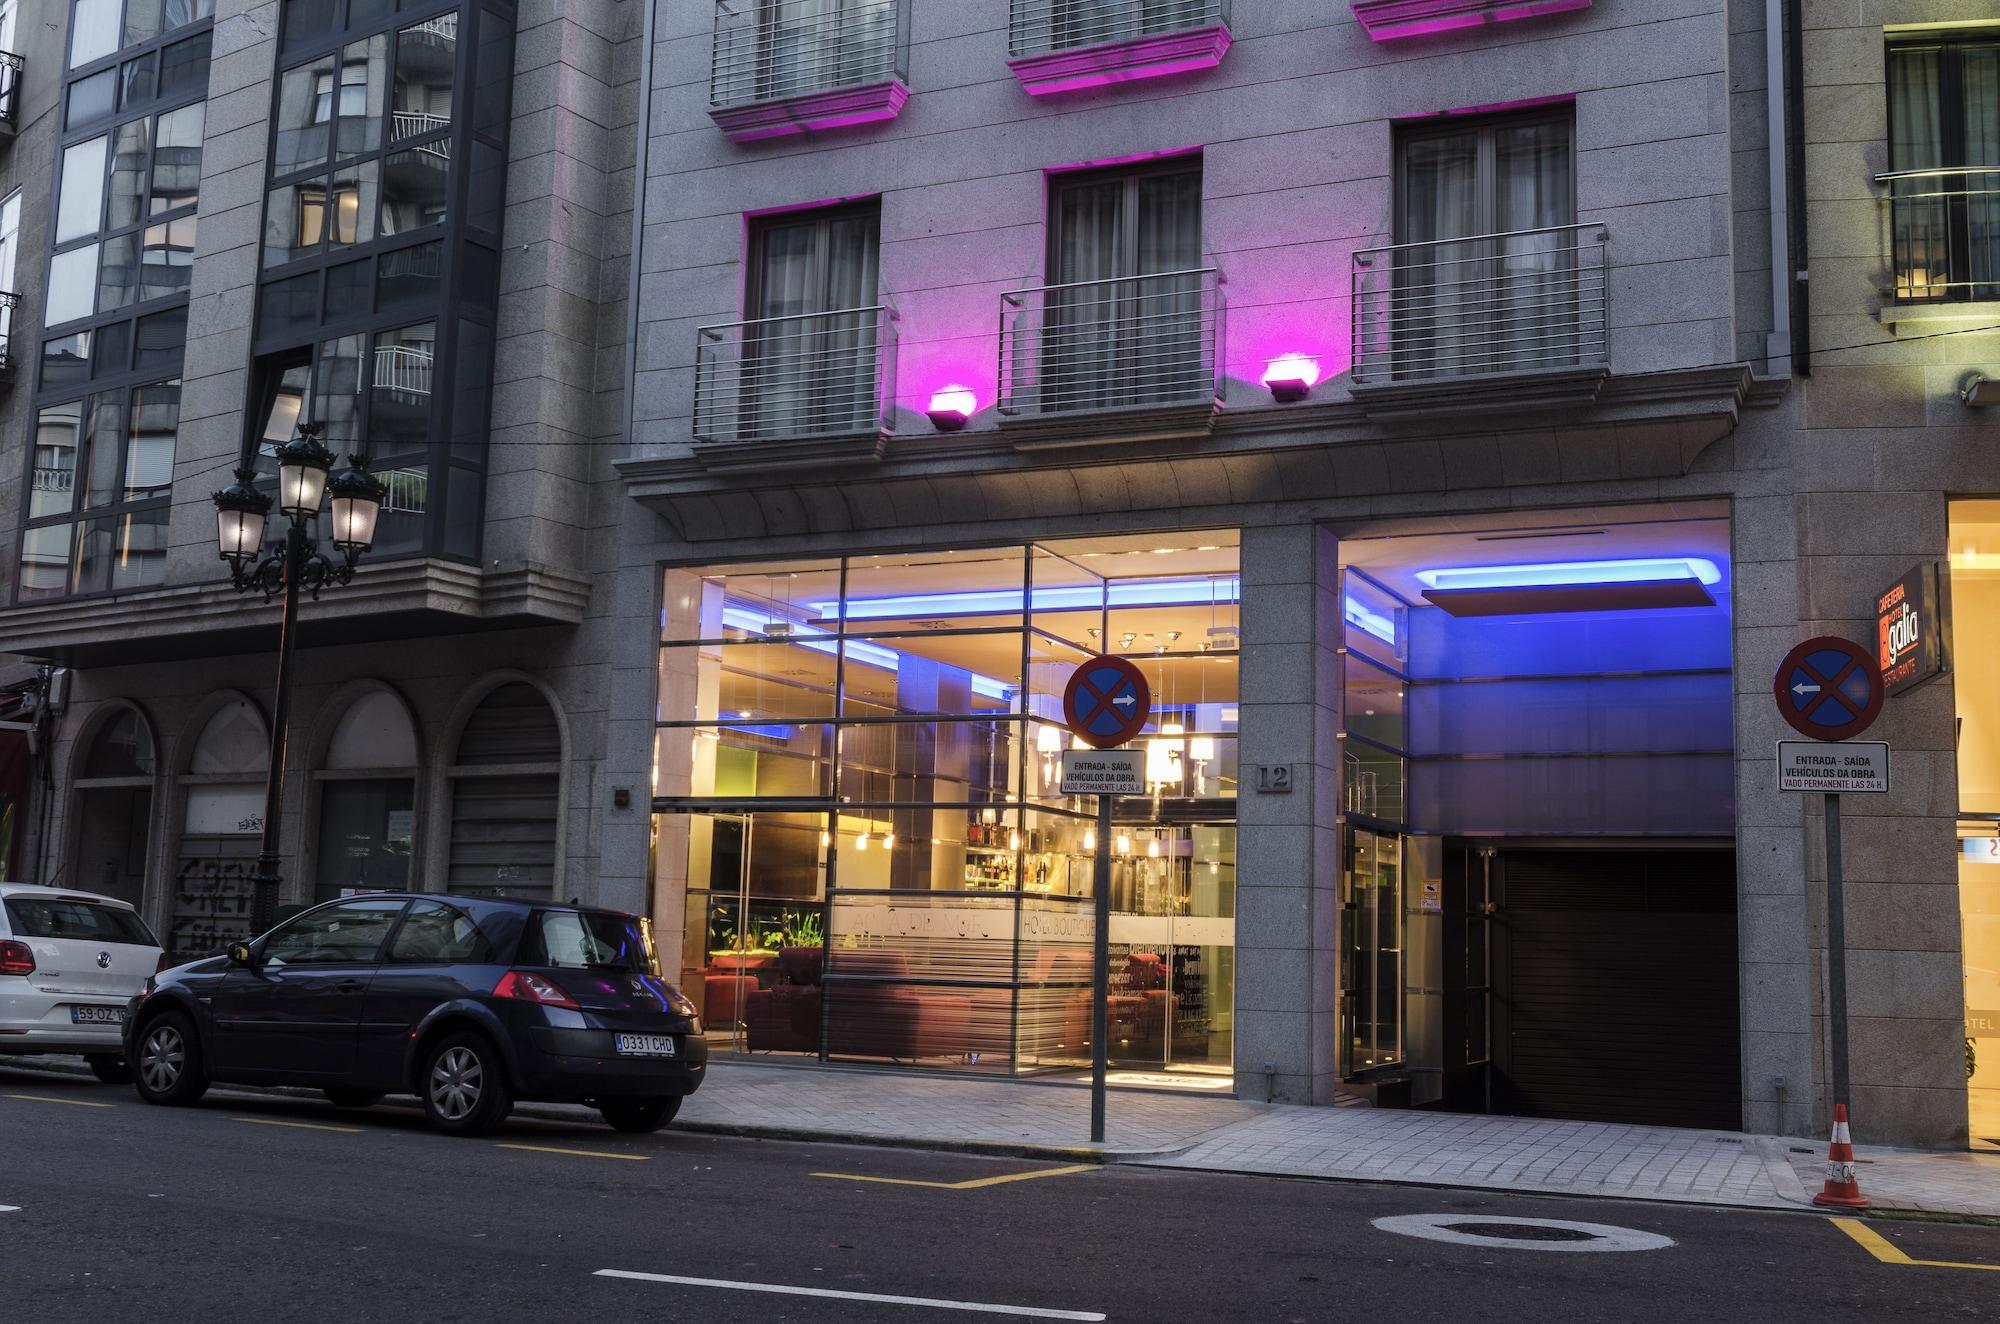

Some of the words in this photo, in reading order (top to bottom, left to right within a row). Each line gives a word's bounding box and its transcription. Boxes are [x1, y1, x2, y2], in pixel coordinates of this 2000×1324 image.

[1882, 657, 1916, 688] ESTAURANTE
[1074, 761, 1106, 771] ENTRADA
[1111, 761, 1132, 771] SAÍDA
[1795, 755, 1837, 766] ENTRADA
[1844, 755, 1871, 766] SAÍDA
[1066, 772, 1104, 782] VEHÍCULOS
[1105, 773, 1116, 782] DA
[1116, 774, 1136, 782] OBRA
[1259, 766, 1288, 788] 12
[1785, 766, 1835, 778] VEHÍCULOS
[1837, 769, 1850, 778] DA
[1851, 769, 1876, 779] OBRA
[1064, 782, 1078, 791] VADO
[1079, 782, 1115, 792] PERMANENTE
[1116, 783, 1127, 792] LAS
[1127, 783, 1135, 792] 24
[1784, 779, 1802, 788] VADO
[1804, 779, 1850, 789] PERMANENTE
[1851, 780, 1865, 789] LAS
[1866, 780, 1875, 790] 24
[622, 1035, 650, 1052] 0331
[653, 1036, 672, 1053] CHD
